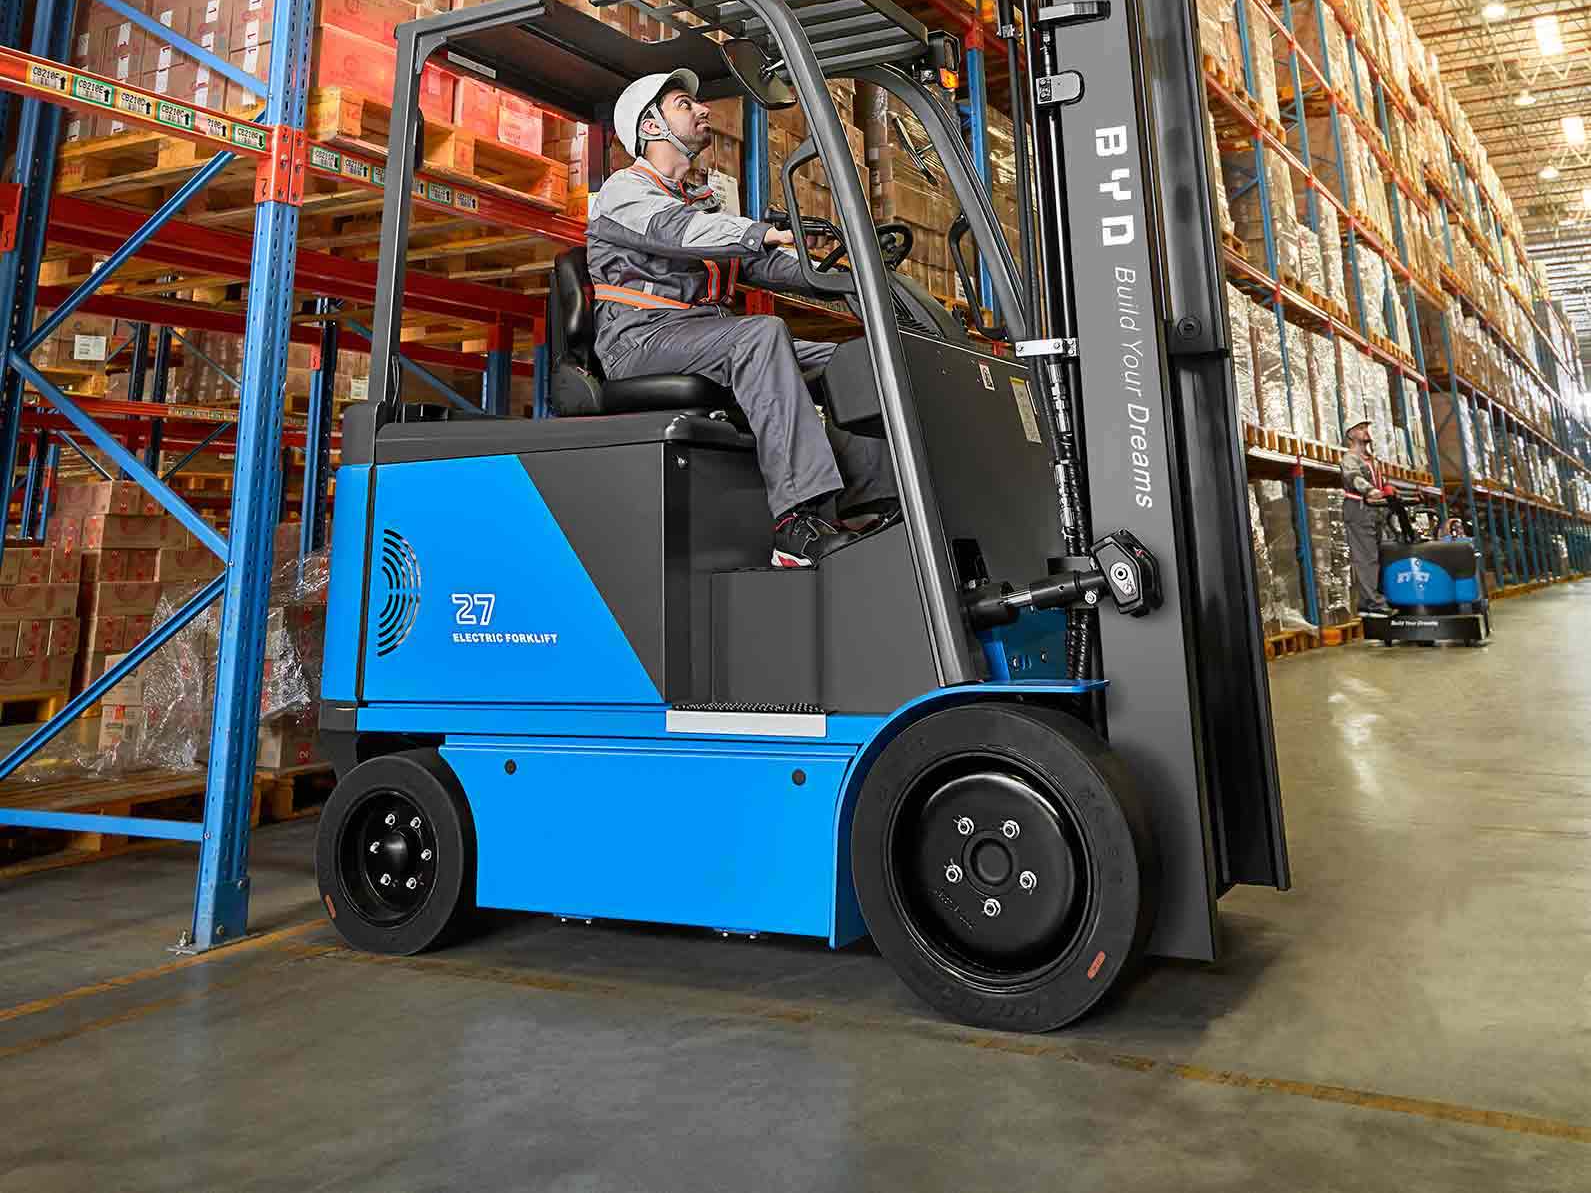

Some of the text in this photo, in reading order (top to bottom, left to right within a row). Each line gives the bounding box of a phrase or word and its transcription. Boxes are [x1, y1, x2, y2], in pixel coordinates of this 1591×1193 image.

[1095, 124, 1135, 247] BYD
[1114, 265, 1153, 508] Build Your Dreams
[451, 593, 496, 626] 27
[452, 632, 558, 644] ELECTRIC FORKLIFT
